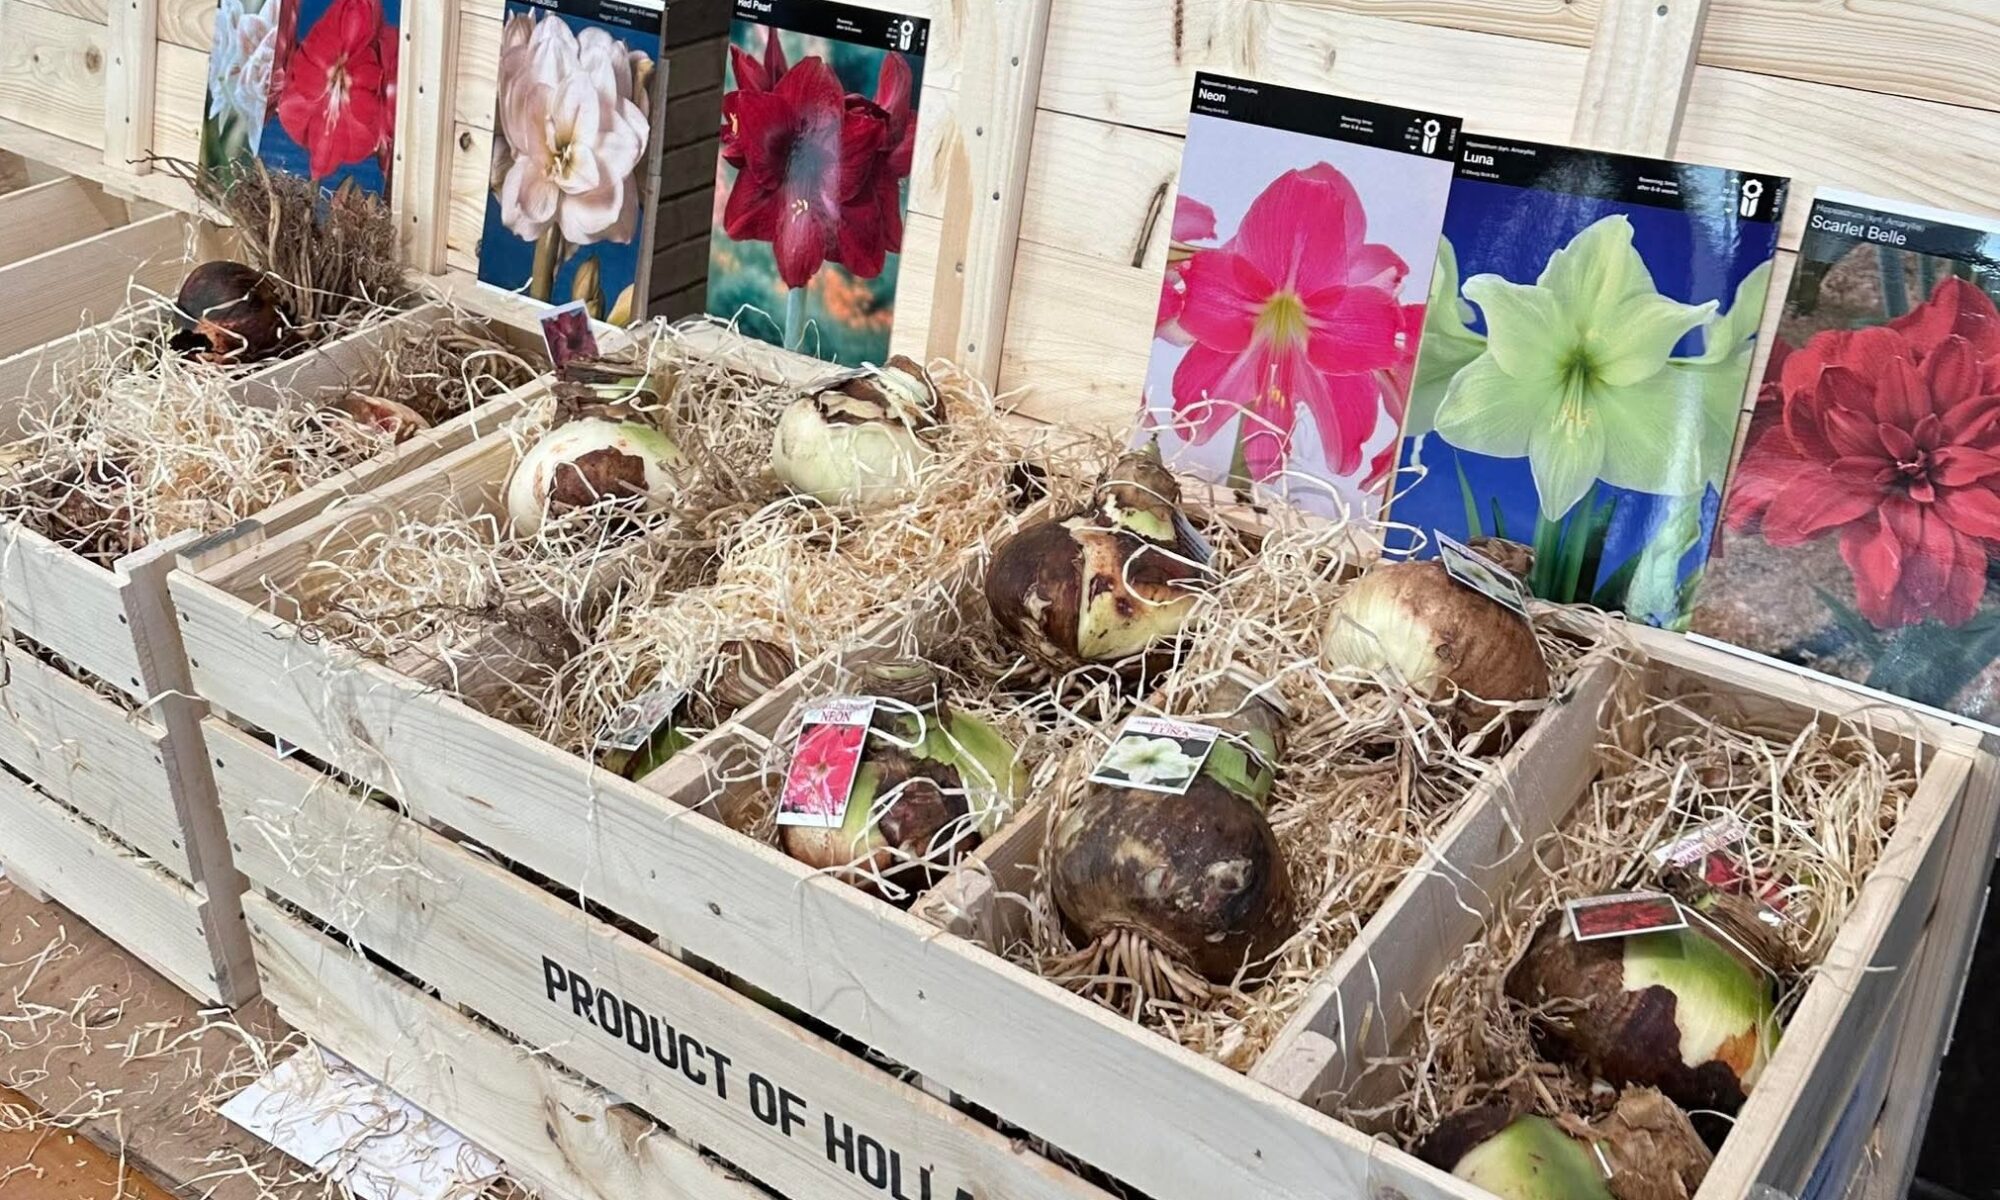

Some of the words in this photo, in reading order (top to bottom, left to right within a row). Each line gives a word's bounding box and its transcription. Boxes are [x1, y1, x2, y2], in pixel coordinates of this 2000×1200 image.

[753, 0, 772, 12] Pearl
[1198, 88, 1226, 103] Neon
[1463, 150, 1494, 166] Luna
[1811, 214, 1865, 238] Scarlet
[1867, 226, 1907, 246] Belle
[542, 954, 731, 1100] PRODUCT
[748, 1071, 806, 1137] OF
[824, 1112, 974, 1200] HOLL
